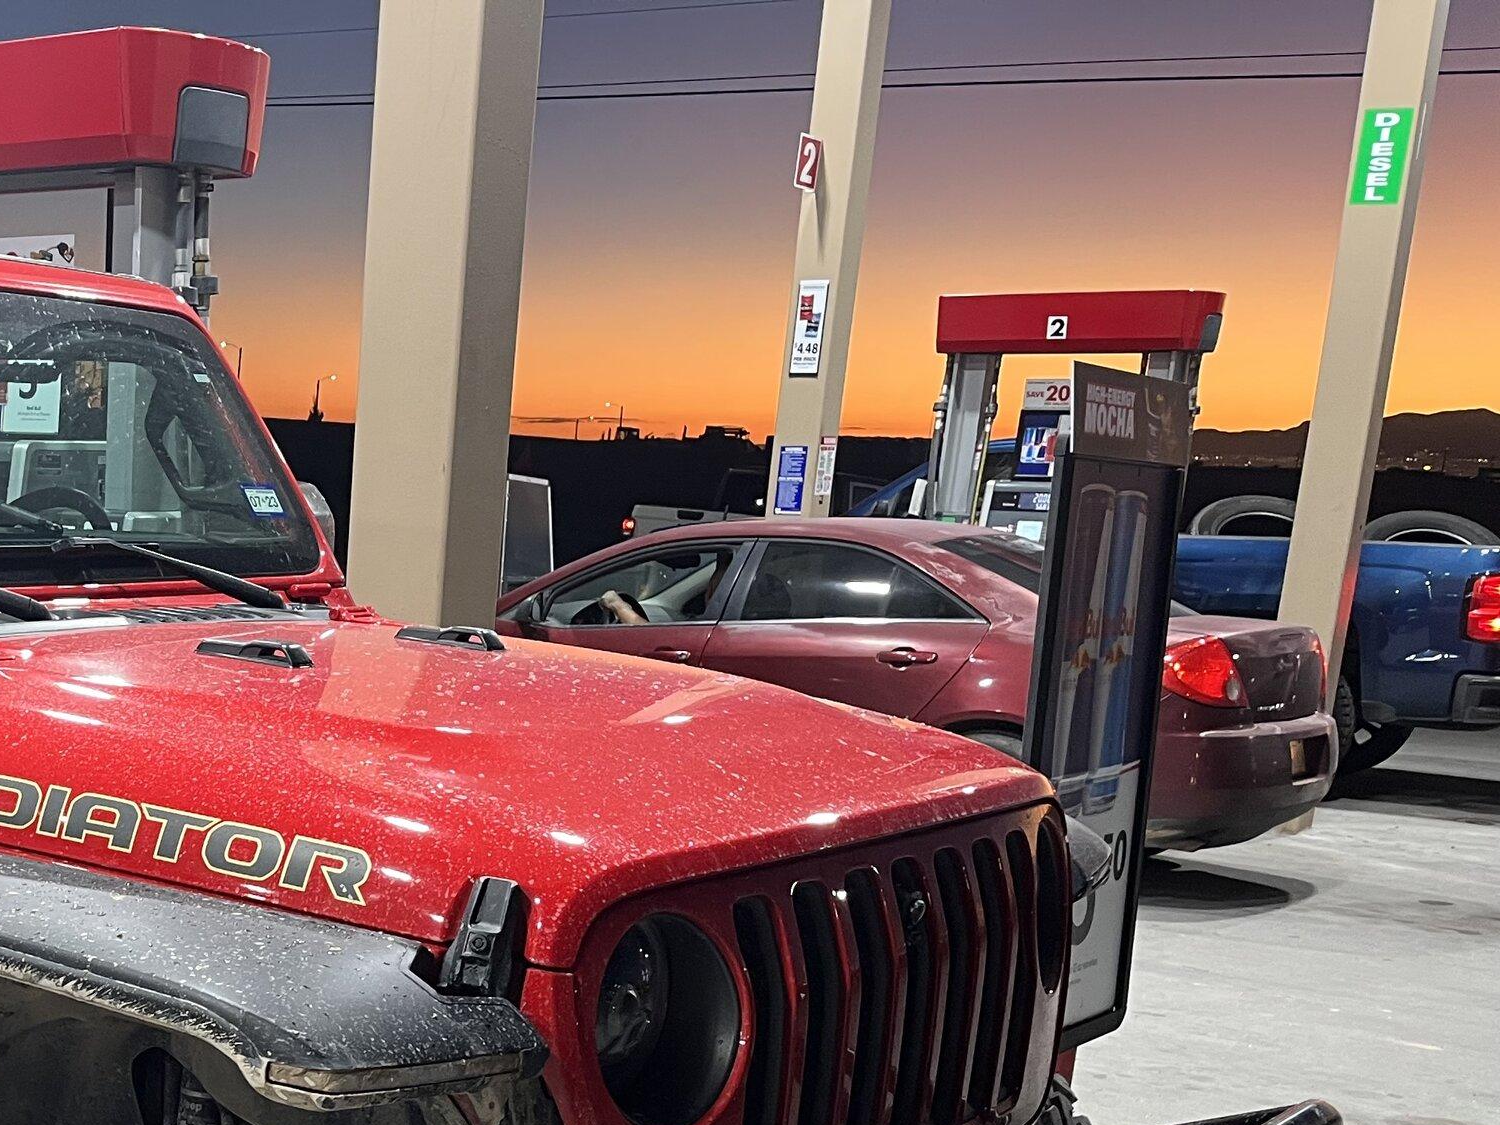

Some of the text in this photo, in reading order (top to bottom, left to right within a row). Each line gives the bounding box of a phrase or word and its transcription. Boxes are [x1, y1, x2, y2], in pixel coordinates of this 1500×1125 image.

[800, 140, 817, 185] 2
[1363, 112, 1401, 201] DIESEL
[1049, 318, 1065, 337] 2
[1084, 402, 1135, 440] MOCHA
